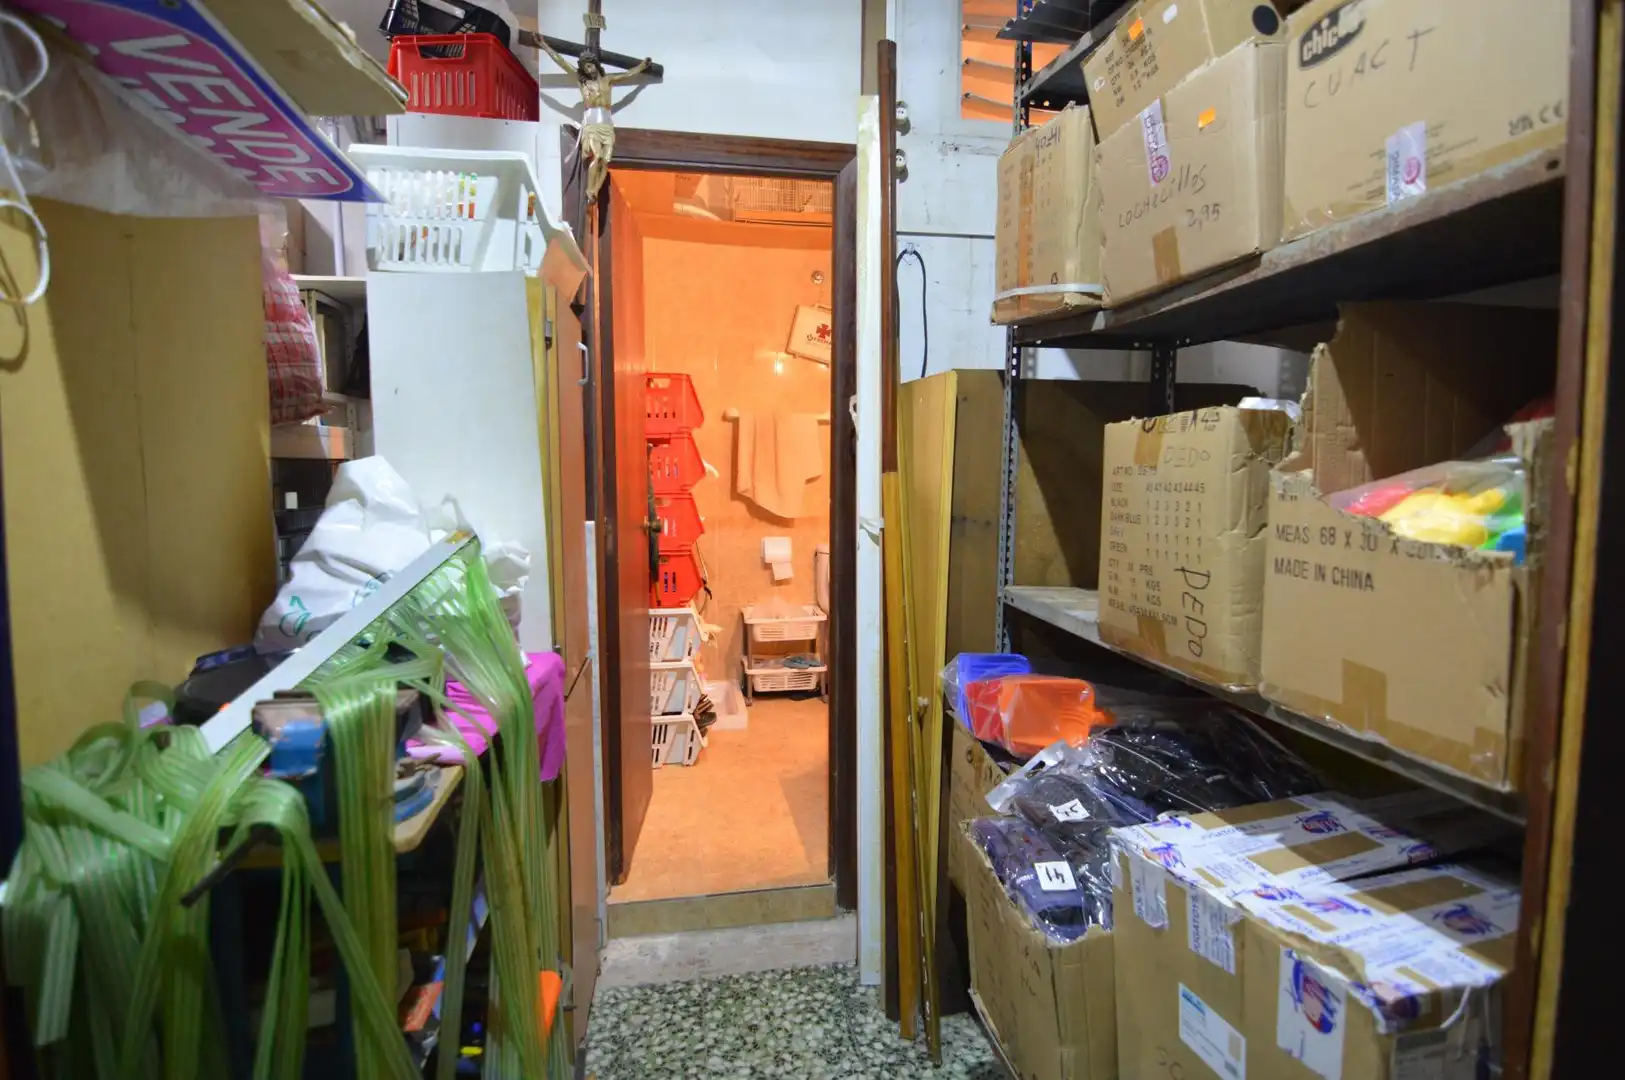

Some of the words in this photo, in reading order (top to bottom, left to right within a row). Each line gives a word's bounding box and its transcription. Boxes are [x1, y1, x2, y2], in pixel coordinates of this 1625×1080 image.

[109, 34, 340, 186] VENDE
[1319, 526, 1336, 547] 68
[1344, 531, 1352, 549] X
[1274, 557, 1309, 580] MADE
[1314, 562, 1326, 582] IN
[1331, 566, 1375, 592] CHINA
[1174, 565, 1211, 658] DEDO
